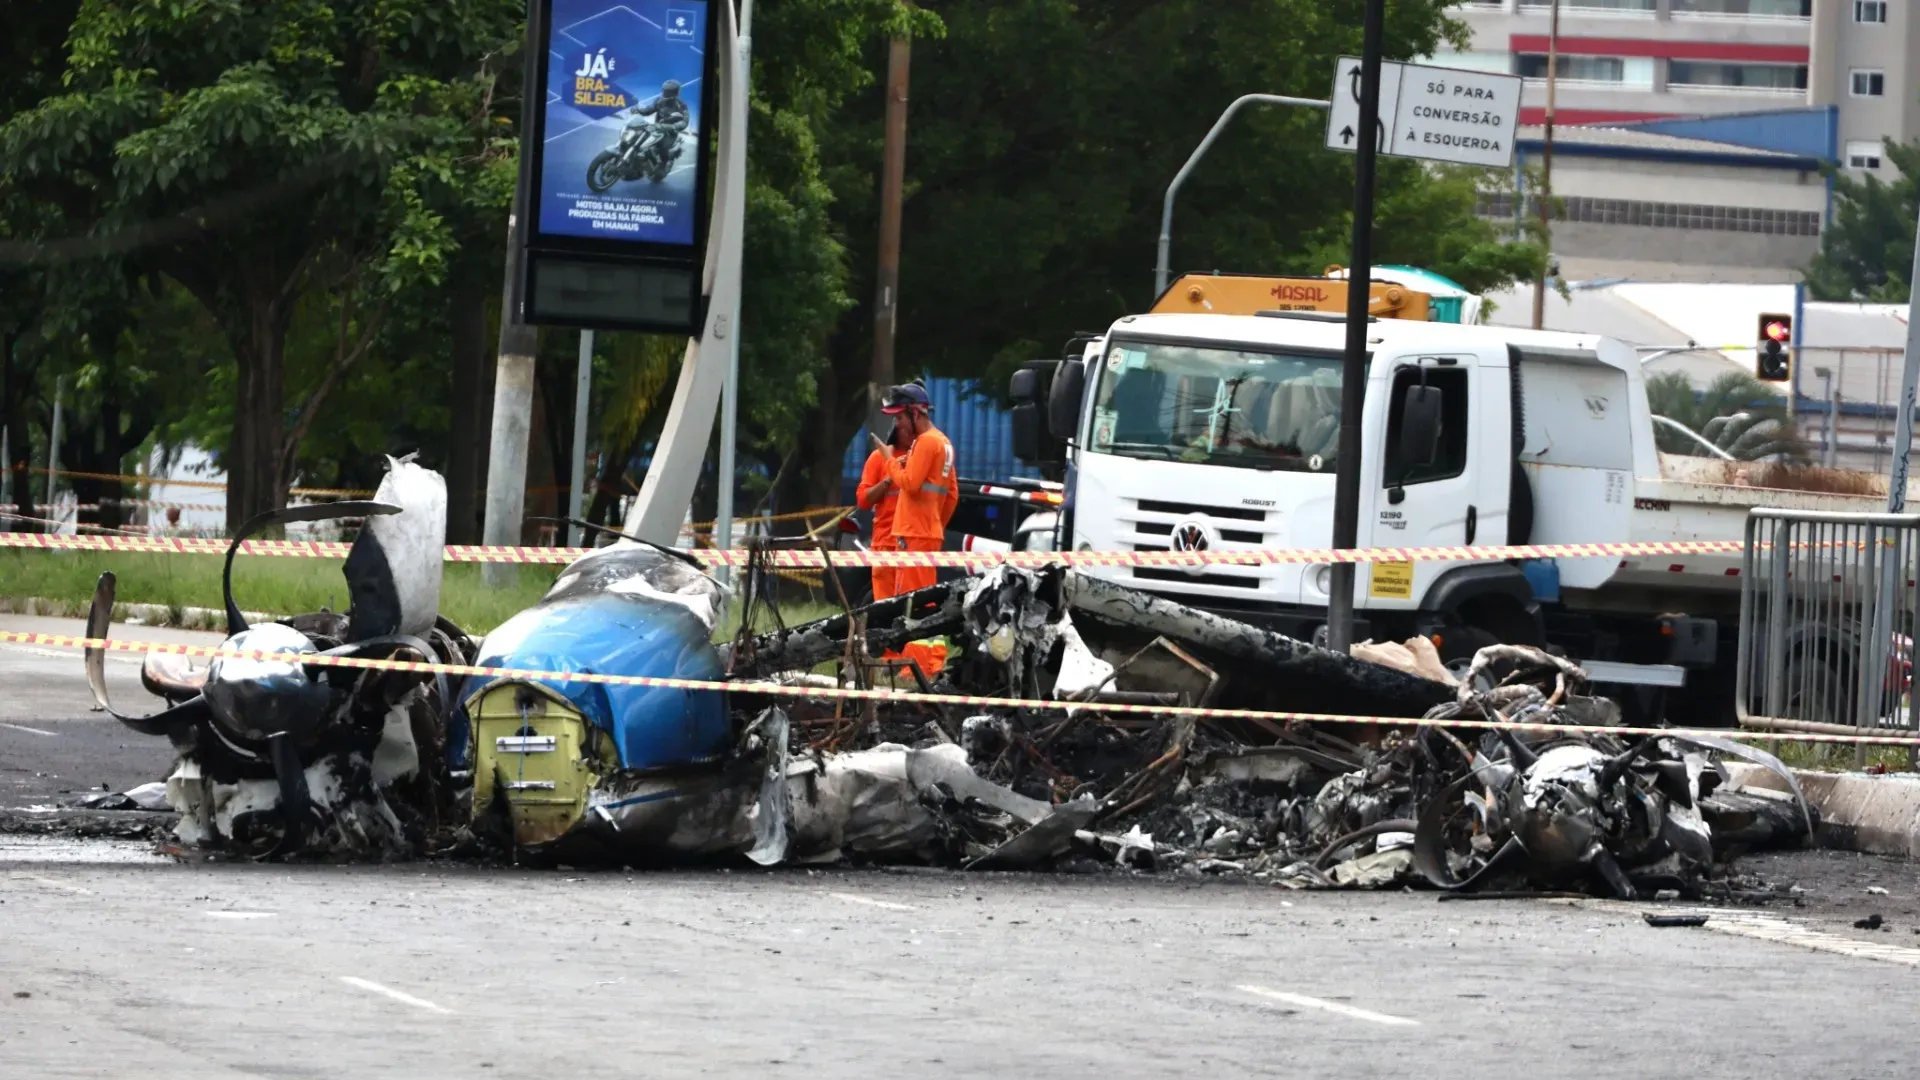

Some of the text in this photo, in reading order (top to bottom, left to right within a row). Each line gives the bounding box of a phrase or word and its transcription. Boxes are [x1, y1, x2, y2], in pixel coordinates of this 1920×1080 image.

[575, 48, 616, 78] JÁ É
[576, 78, 609, 91] BRA-
[1427, 80, 1494, 100] SÓ PARA
[575, 91, 625, 107] SILEIRA
[1413, 106, 1500, 126] CONVERSÃO
[1406, 127, 1500, 151] À ESQUERDA
[568, 208, 617, 220] PRODUZIDAS
[618, 212, 630, 220] NA
[576, 200, 602, 210] MOTOS
[604, 202, 629, 212] BAJAJ
[630, 205, 657, 213] AGORA
[592, 220, 639, 231] EM MANAUS
[1271, 285, 1328, 302] MASAL
[1242, 498, 1276, 507] ROBUST
